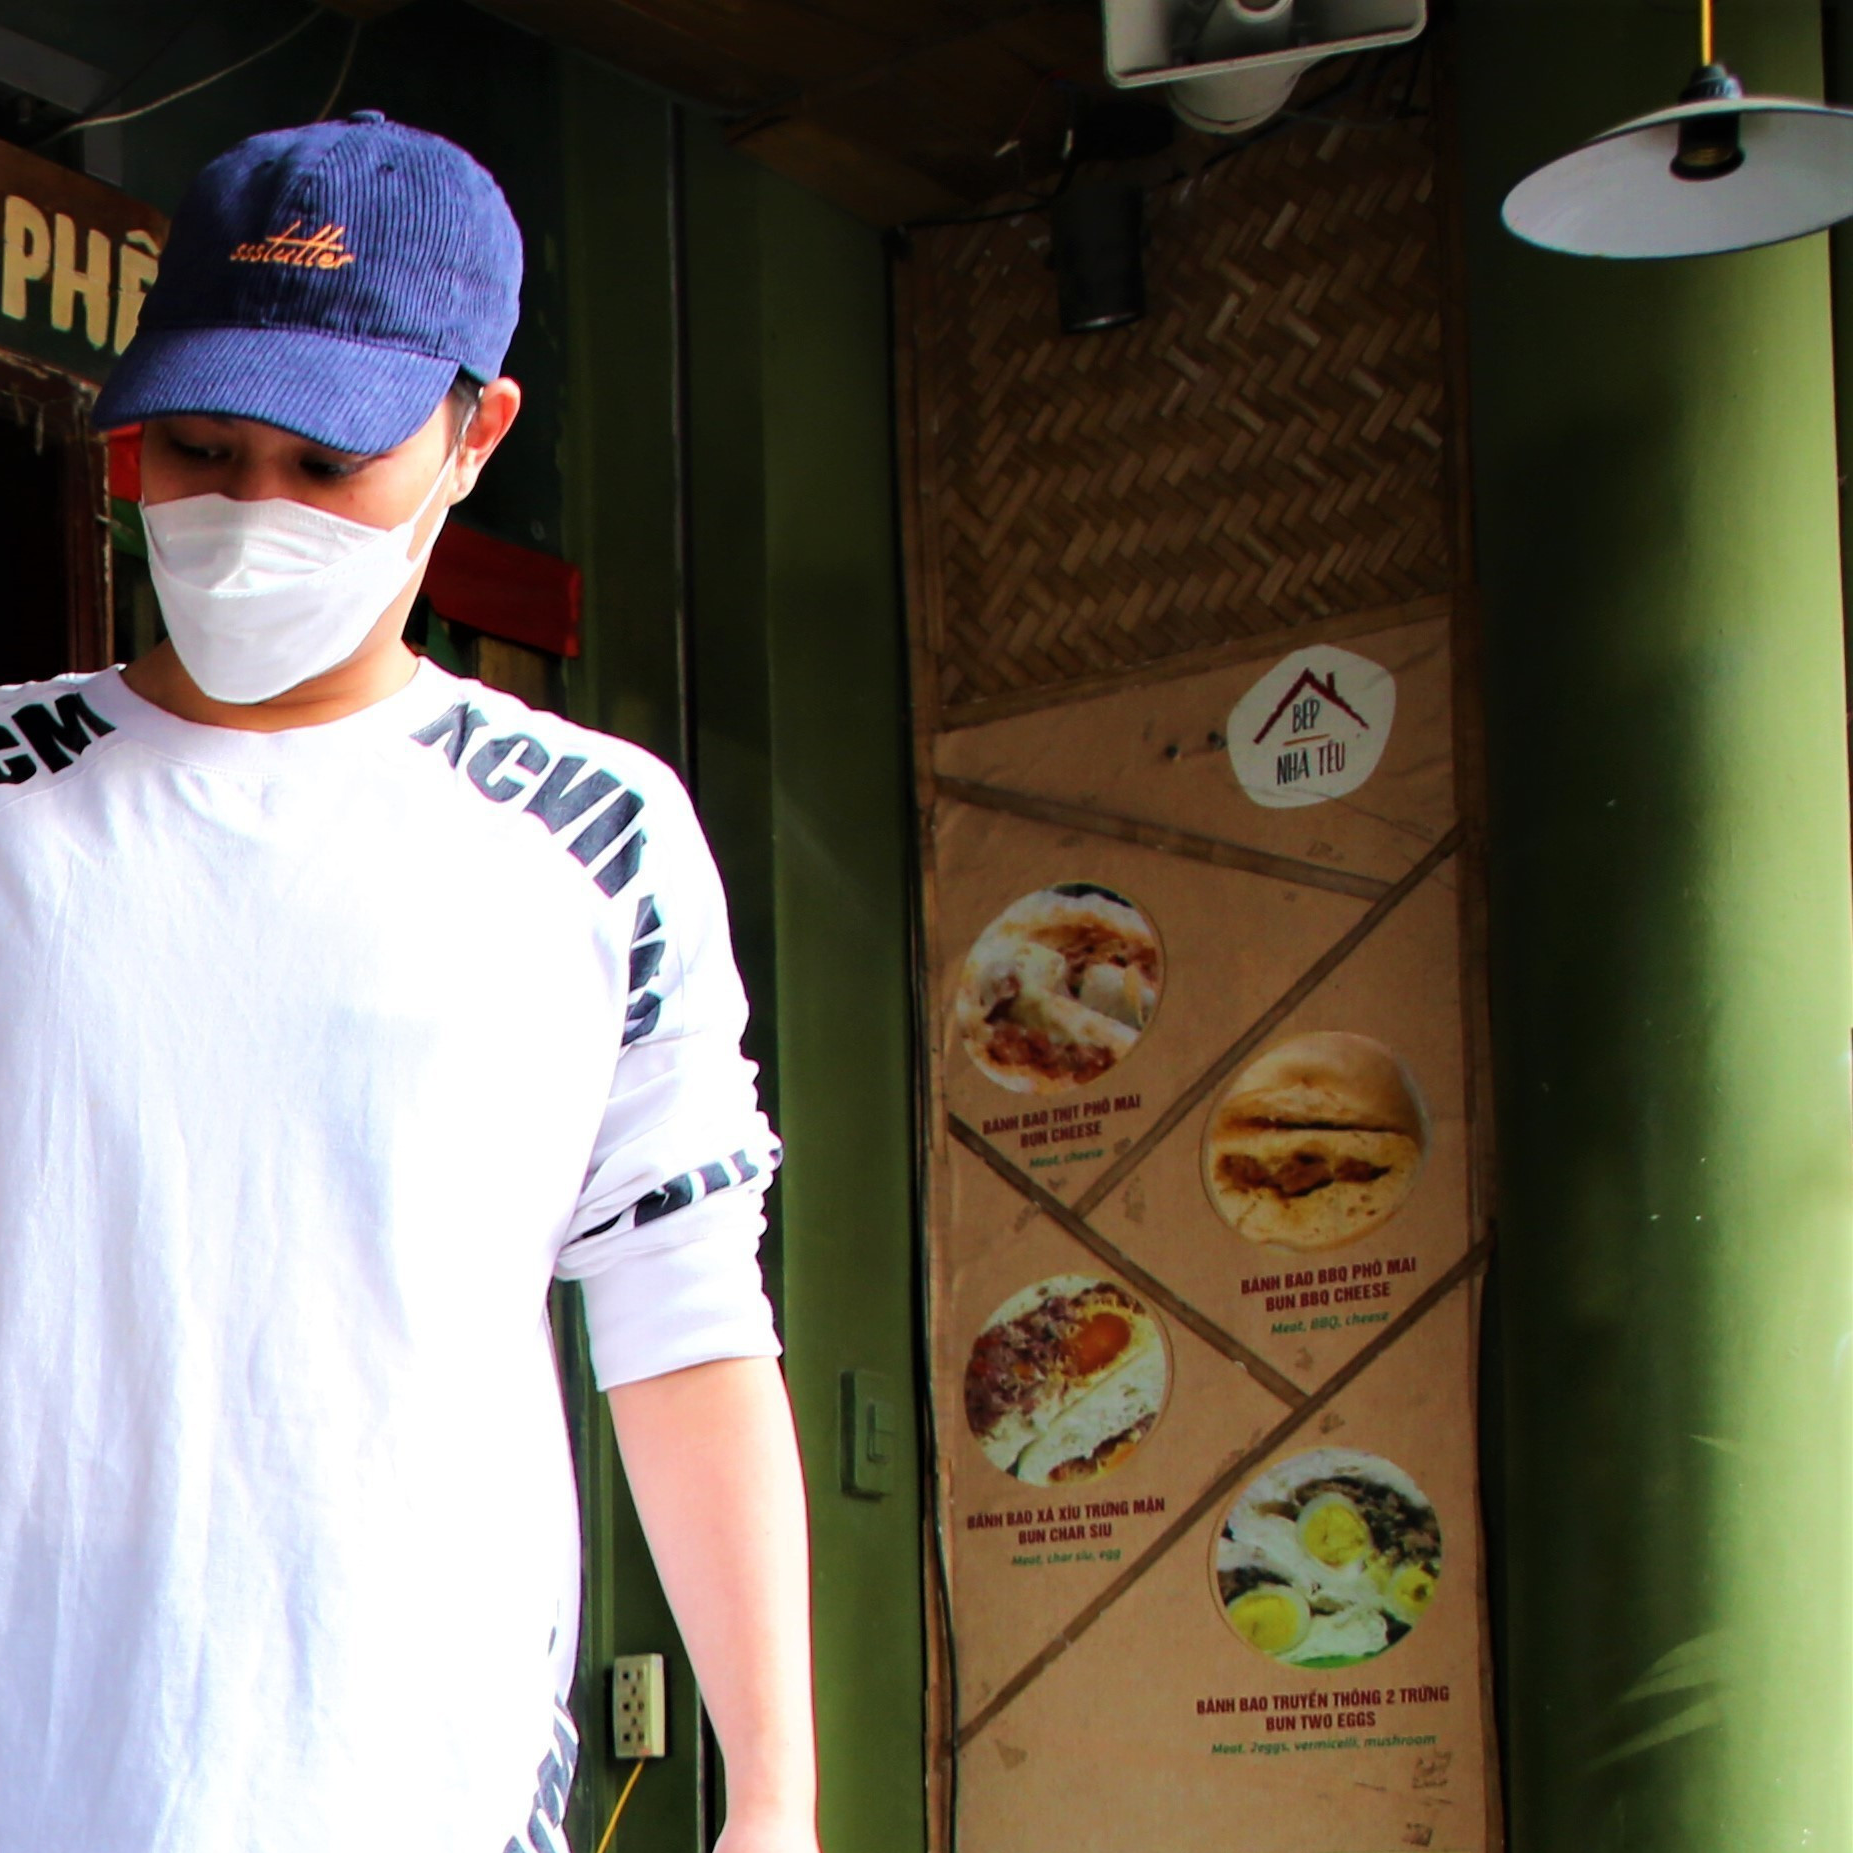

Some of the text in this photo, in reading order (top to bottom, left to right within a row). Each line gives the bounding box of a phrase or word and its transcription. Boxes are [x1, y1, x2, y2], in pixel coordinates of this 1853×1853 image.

[1051, 1120, 1102, 1143] CHEESE
[1285, 1270, 1313, 1289] BAO
[1318, 1265, 1347, 1285] BBQ
[1387, 1256, 1417, 1275] MAI
[1265, 1281, 1391, 1312] BUN BBQ CHEESE
[1006, 1510, 1032, 1526] BAO
[1018, 1522, 1112, 1545] BUN CHAR SIU
[1239, 1695, 1268, 1713] BAO
[1385, 1688, 1396, 1706] 2
[1265, 1711, 1376, 1732] BUN TWO EGGS
[1364, 1732, 1438, 1749] mushroom
